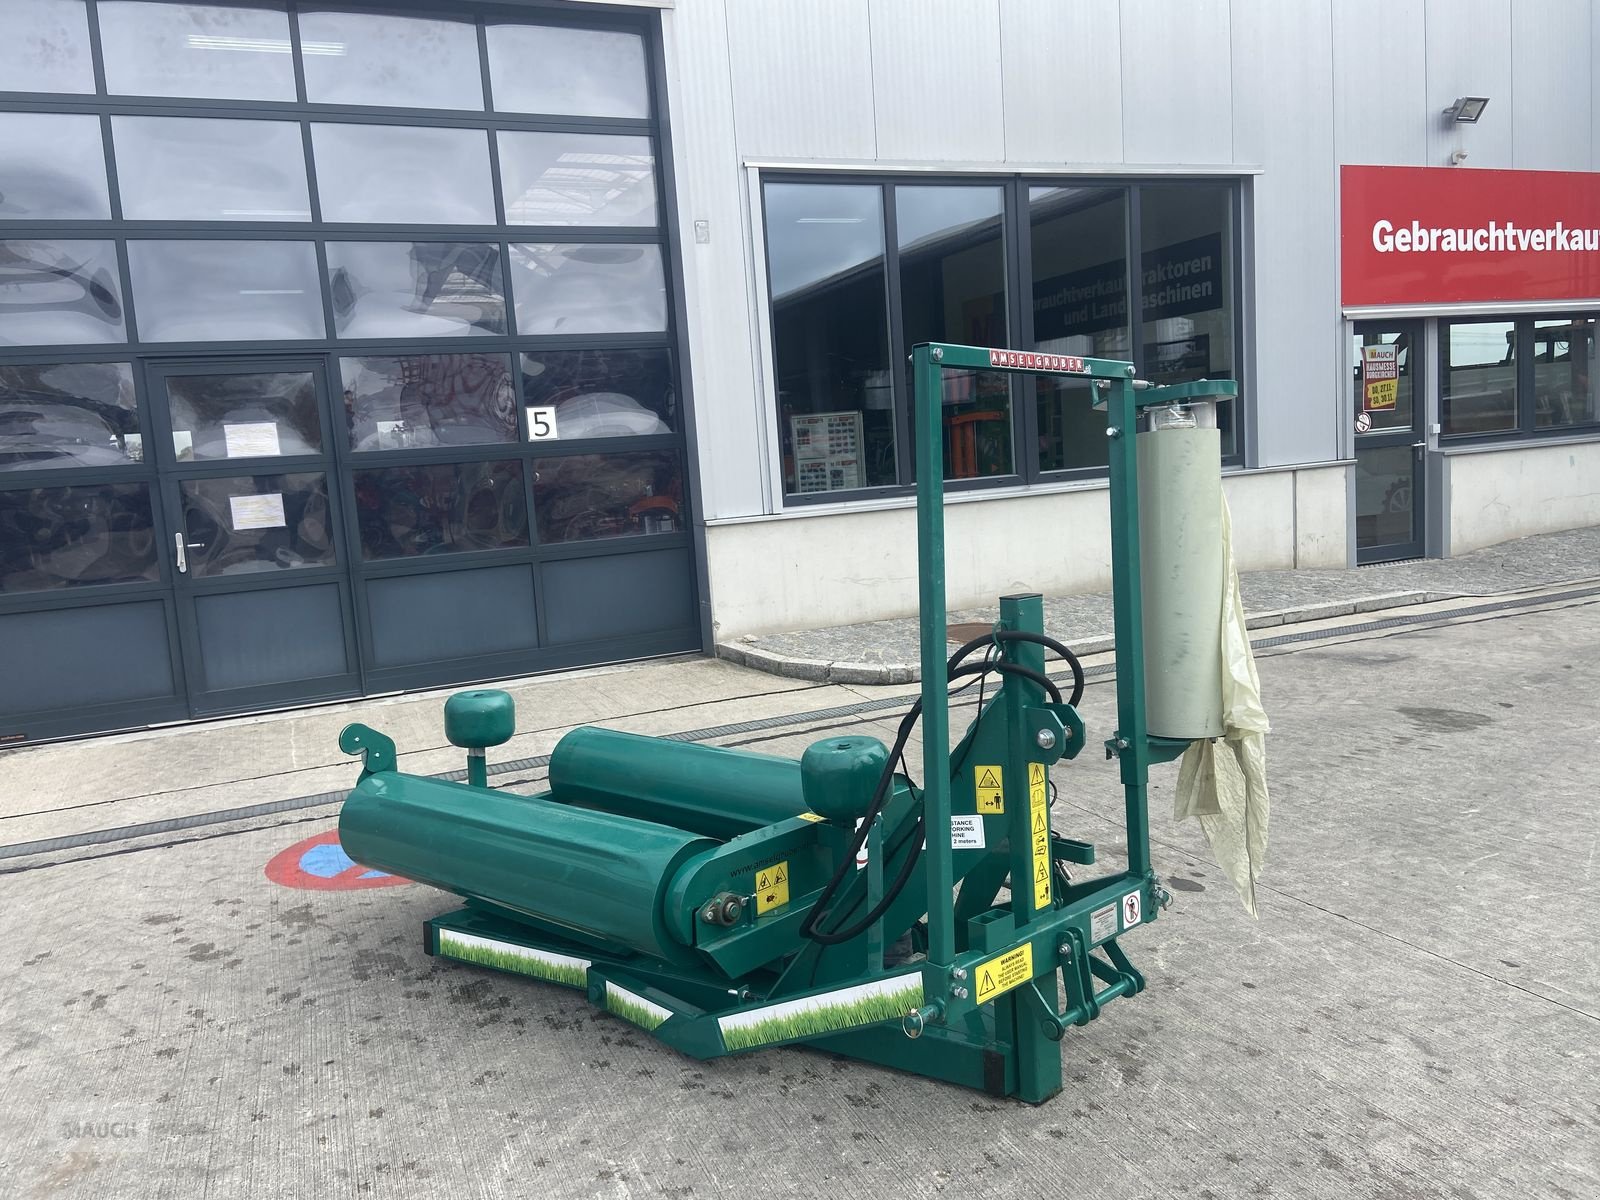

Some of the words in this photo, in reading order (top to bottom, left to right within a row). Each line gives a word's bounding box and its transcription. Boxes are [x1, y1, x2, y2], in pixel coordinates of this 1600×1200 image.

[1372, 219, 1600, 252] Gebrauchtverkau
[1033, 277, 1127, 311] rauchtverkau
[1142, 255, 1212, 284] raktoren
[1064, 304, 1088, 326] und
[991, 351, 1083, 370] AMSELGRUBER
[1370, 351, 1393, 359] MAUCH
[534, 411, 550, 437] 5
[1001, 950, 1024, 965] WARNING!
